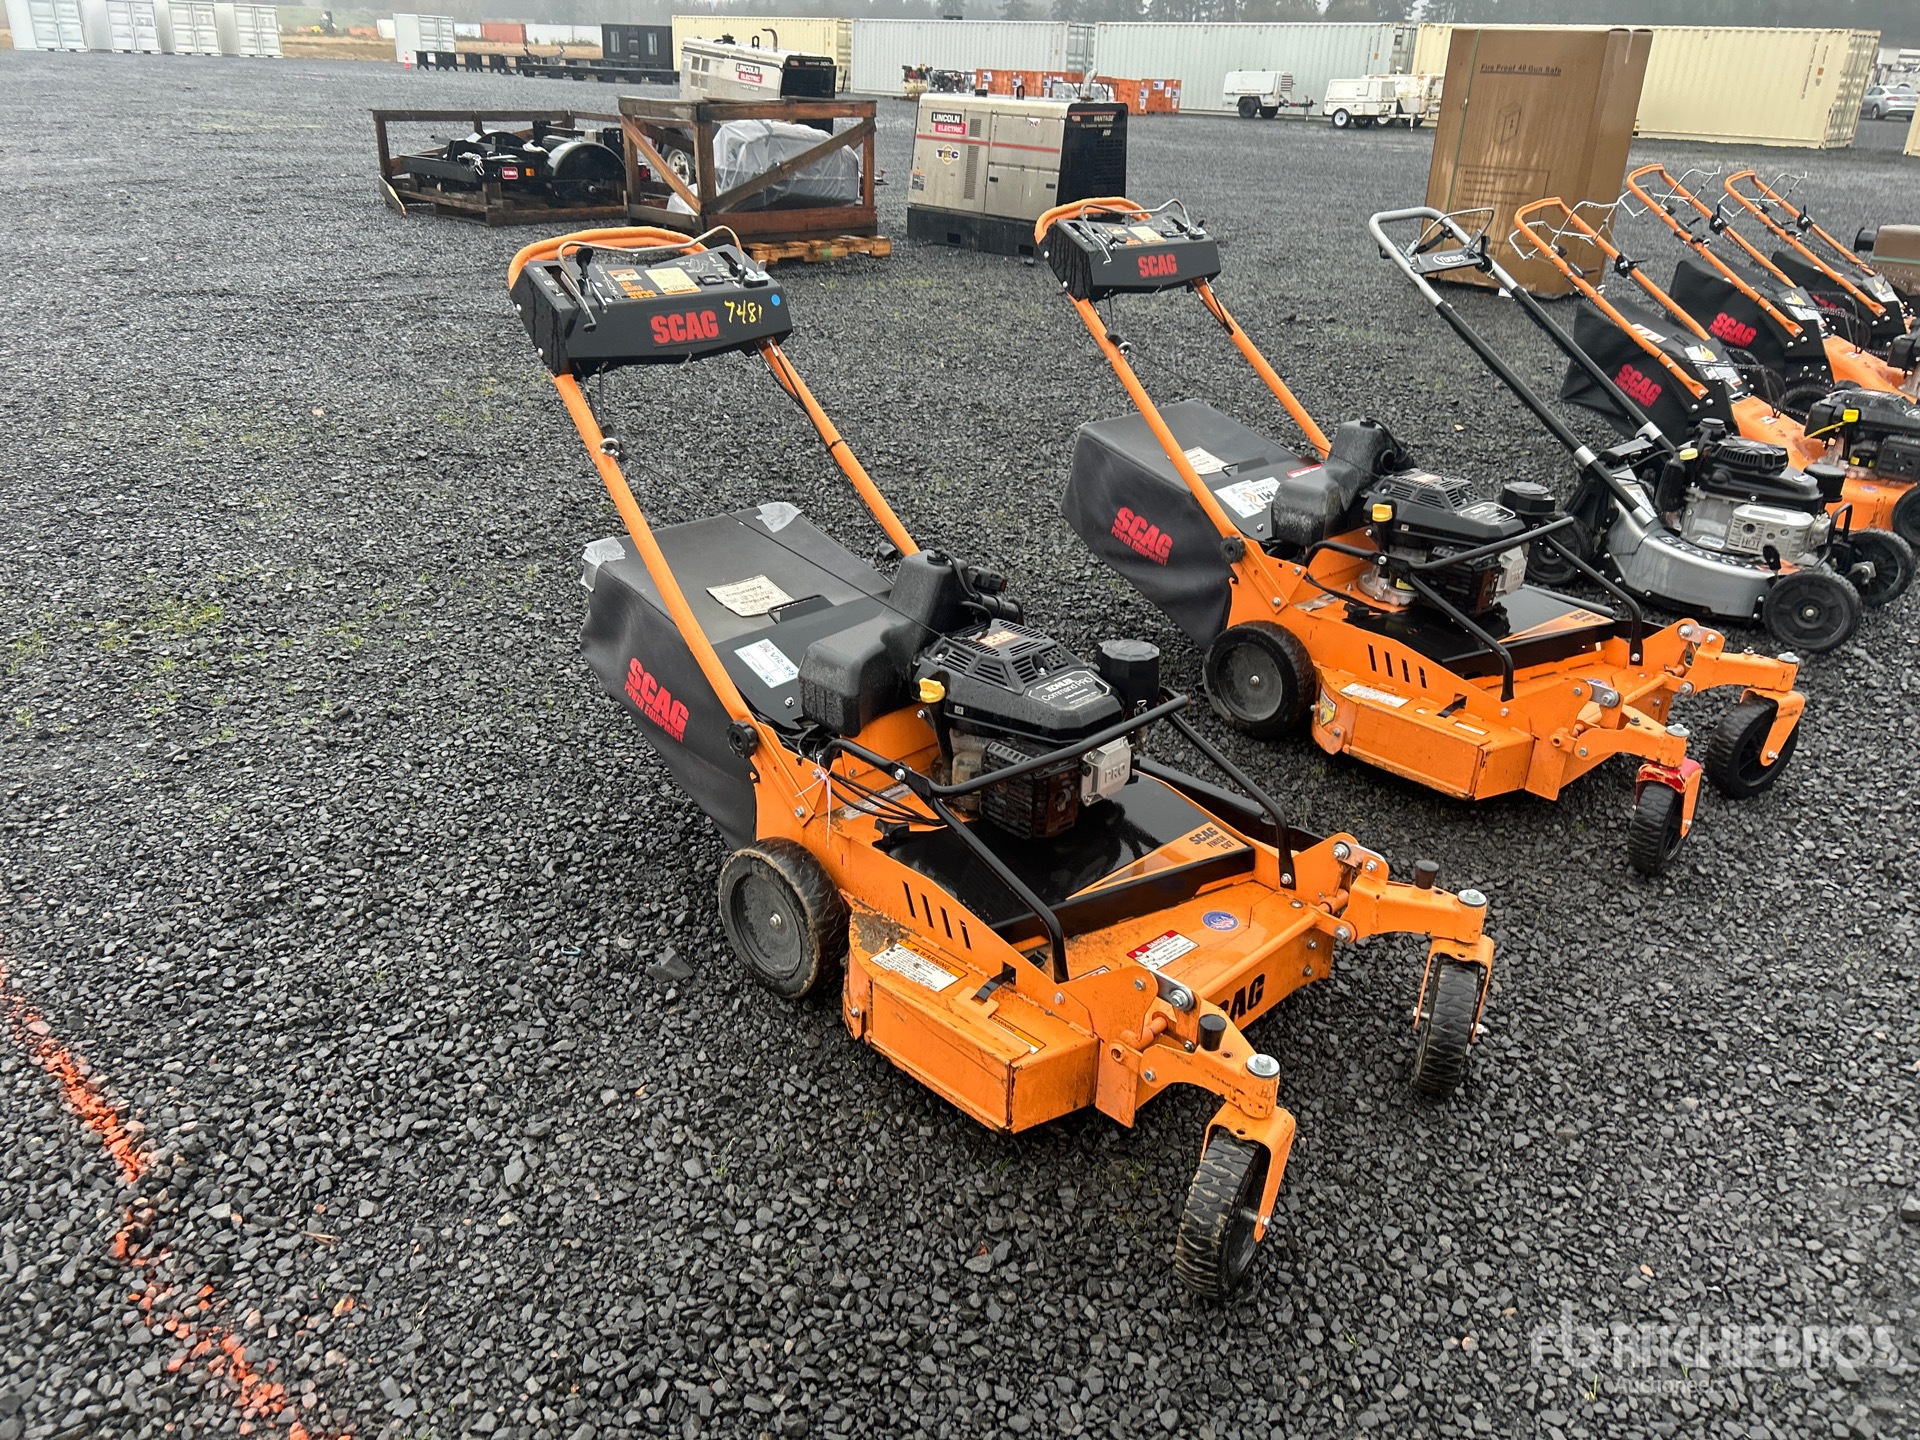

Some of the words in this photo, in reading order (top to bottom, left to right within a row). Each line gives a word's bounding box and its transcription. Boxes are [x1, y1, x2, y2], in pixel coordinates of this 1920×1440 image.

[736, 63, 760, 74] LINCOLN
[740, 74, 761, 83] ELECTRIC
[1480, 63, 1494, 72] Fire
[1496, 63, 1516, 72] Proof
[1518, 63, 1527, 72] 40
[1528, 64, 1543, 73] Gun
[1545, 66, 1562, 74] Safe
[932, 113, 961, 124] LINCOLN
[937, 125, 964, 133] ELECTRIC
[1137, 253, 1178, 278] SCAG
[724, 299, 763, 325] 7481
[649, 309, 720, 345] SCAG
[1713, 312, 1757, 343] SCAG
[1618, 363, 1662, 402] SCAG
[1114, 506, 1173, 559] SCAG
[1742, 537, 1761, 548] HOT
[1111, 525, 1132, 547] POWER
[1132, 540, 1169, 567] EQUIPMENT
[1041, 683, 1079, 701] Command
[1075, 676, 1094, 687] PRO
[1045, 677, 1075, 693] KOHLER
[627, 657, 690, 734] SCAG
[624, 680, 645, 711] POWER
[644, 704, 685, 744] EQUIPMENT
[1105, 762, 1126, 783] PRO
[1188, 827, 1219, 845] SCAG
[1206, 835, 1228, 848] FINISH
[1220, 840, 1235, 850] CUT
[920, 950, 952, 970] WARNING
